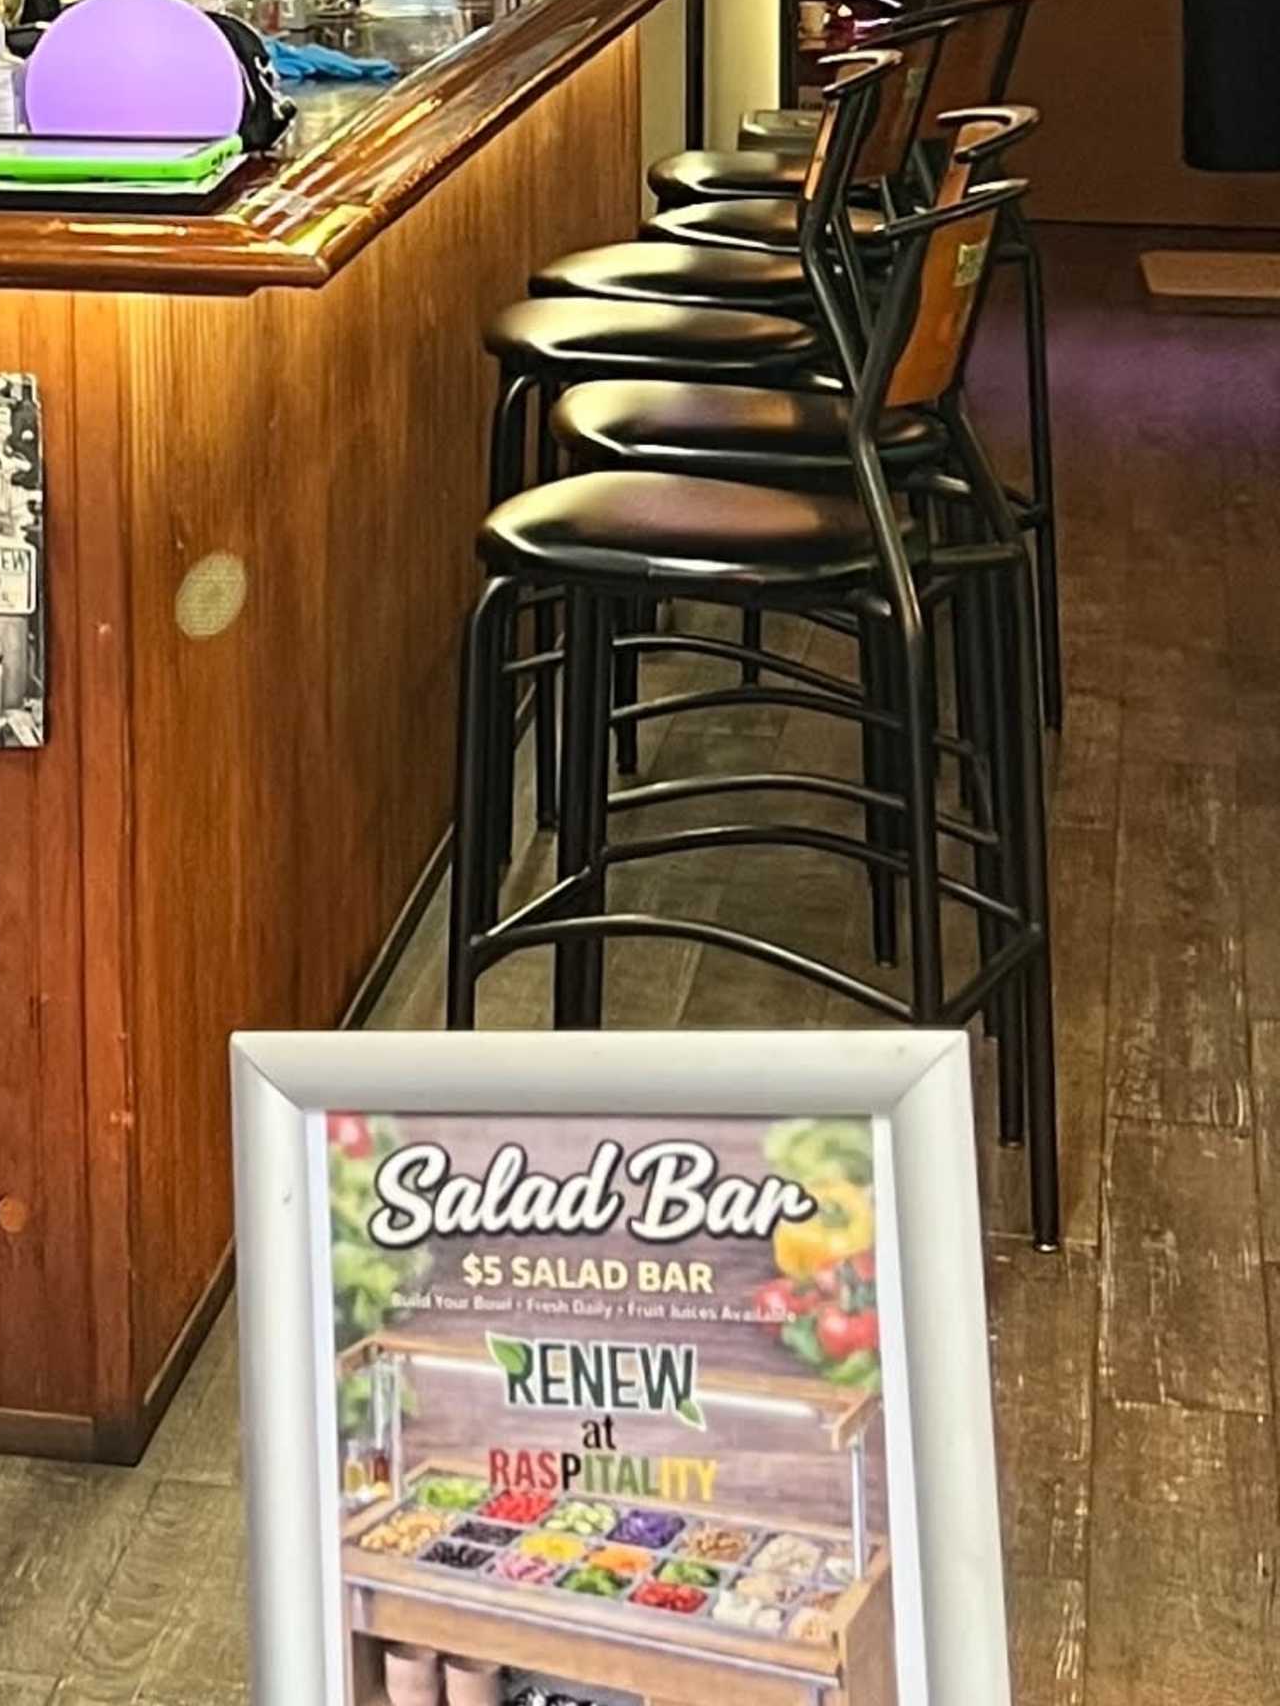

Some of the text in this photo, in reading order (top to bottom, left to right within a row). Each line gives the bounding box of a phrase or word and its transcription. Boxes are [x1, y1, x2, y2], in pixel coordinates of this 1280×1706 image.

[368, 1140, 817, 1249] Salad Bar
[462, 1253, 714, 1294] $5 SALAD BAR
[489, 1338, 697, 1411] RENEW
[581, 1414, 617, 1450] at
[489, 1448, 718, 1502] RASPITALITY
